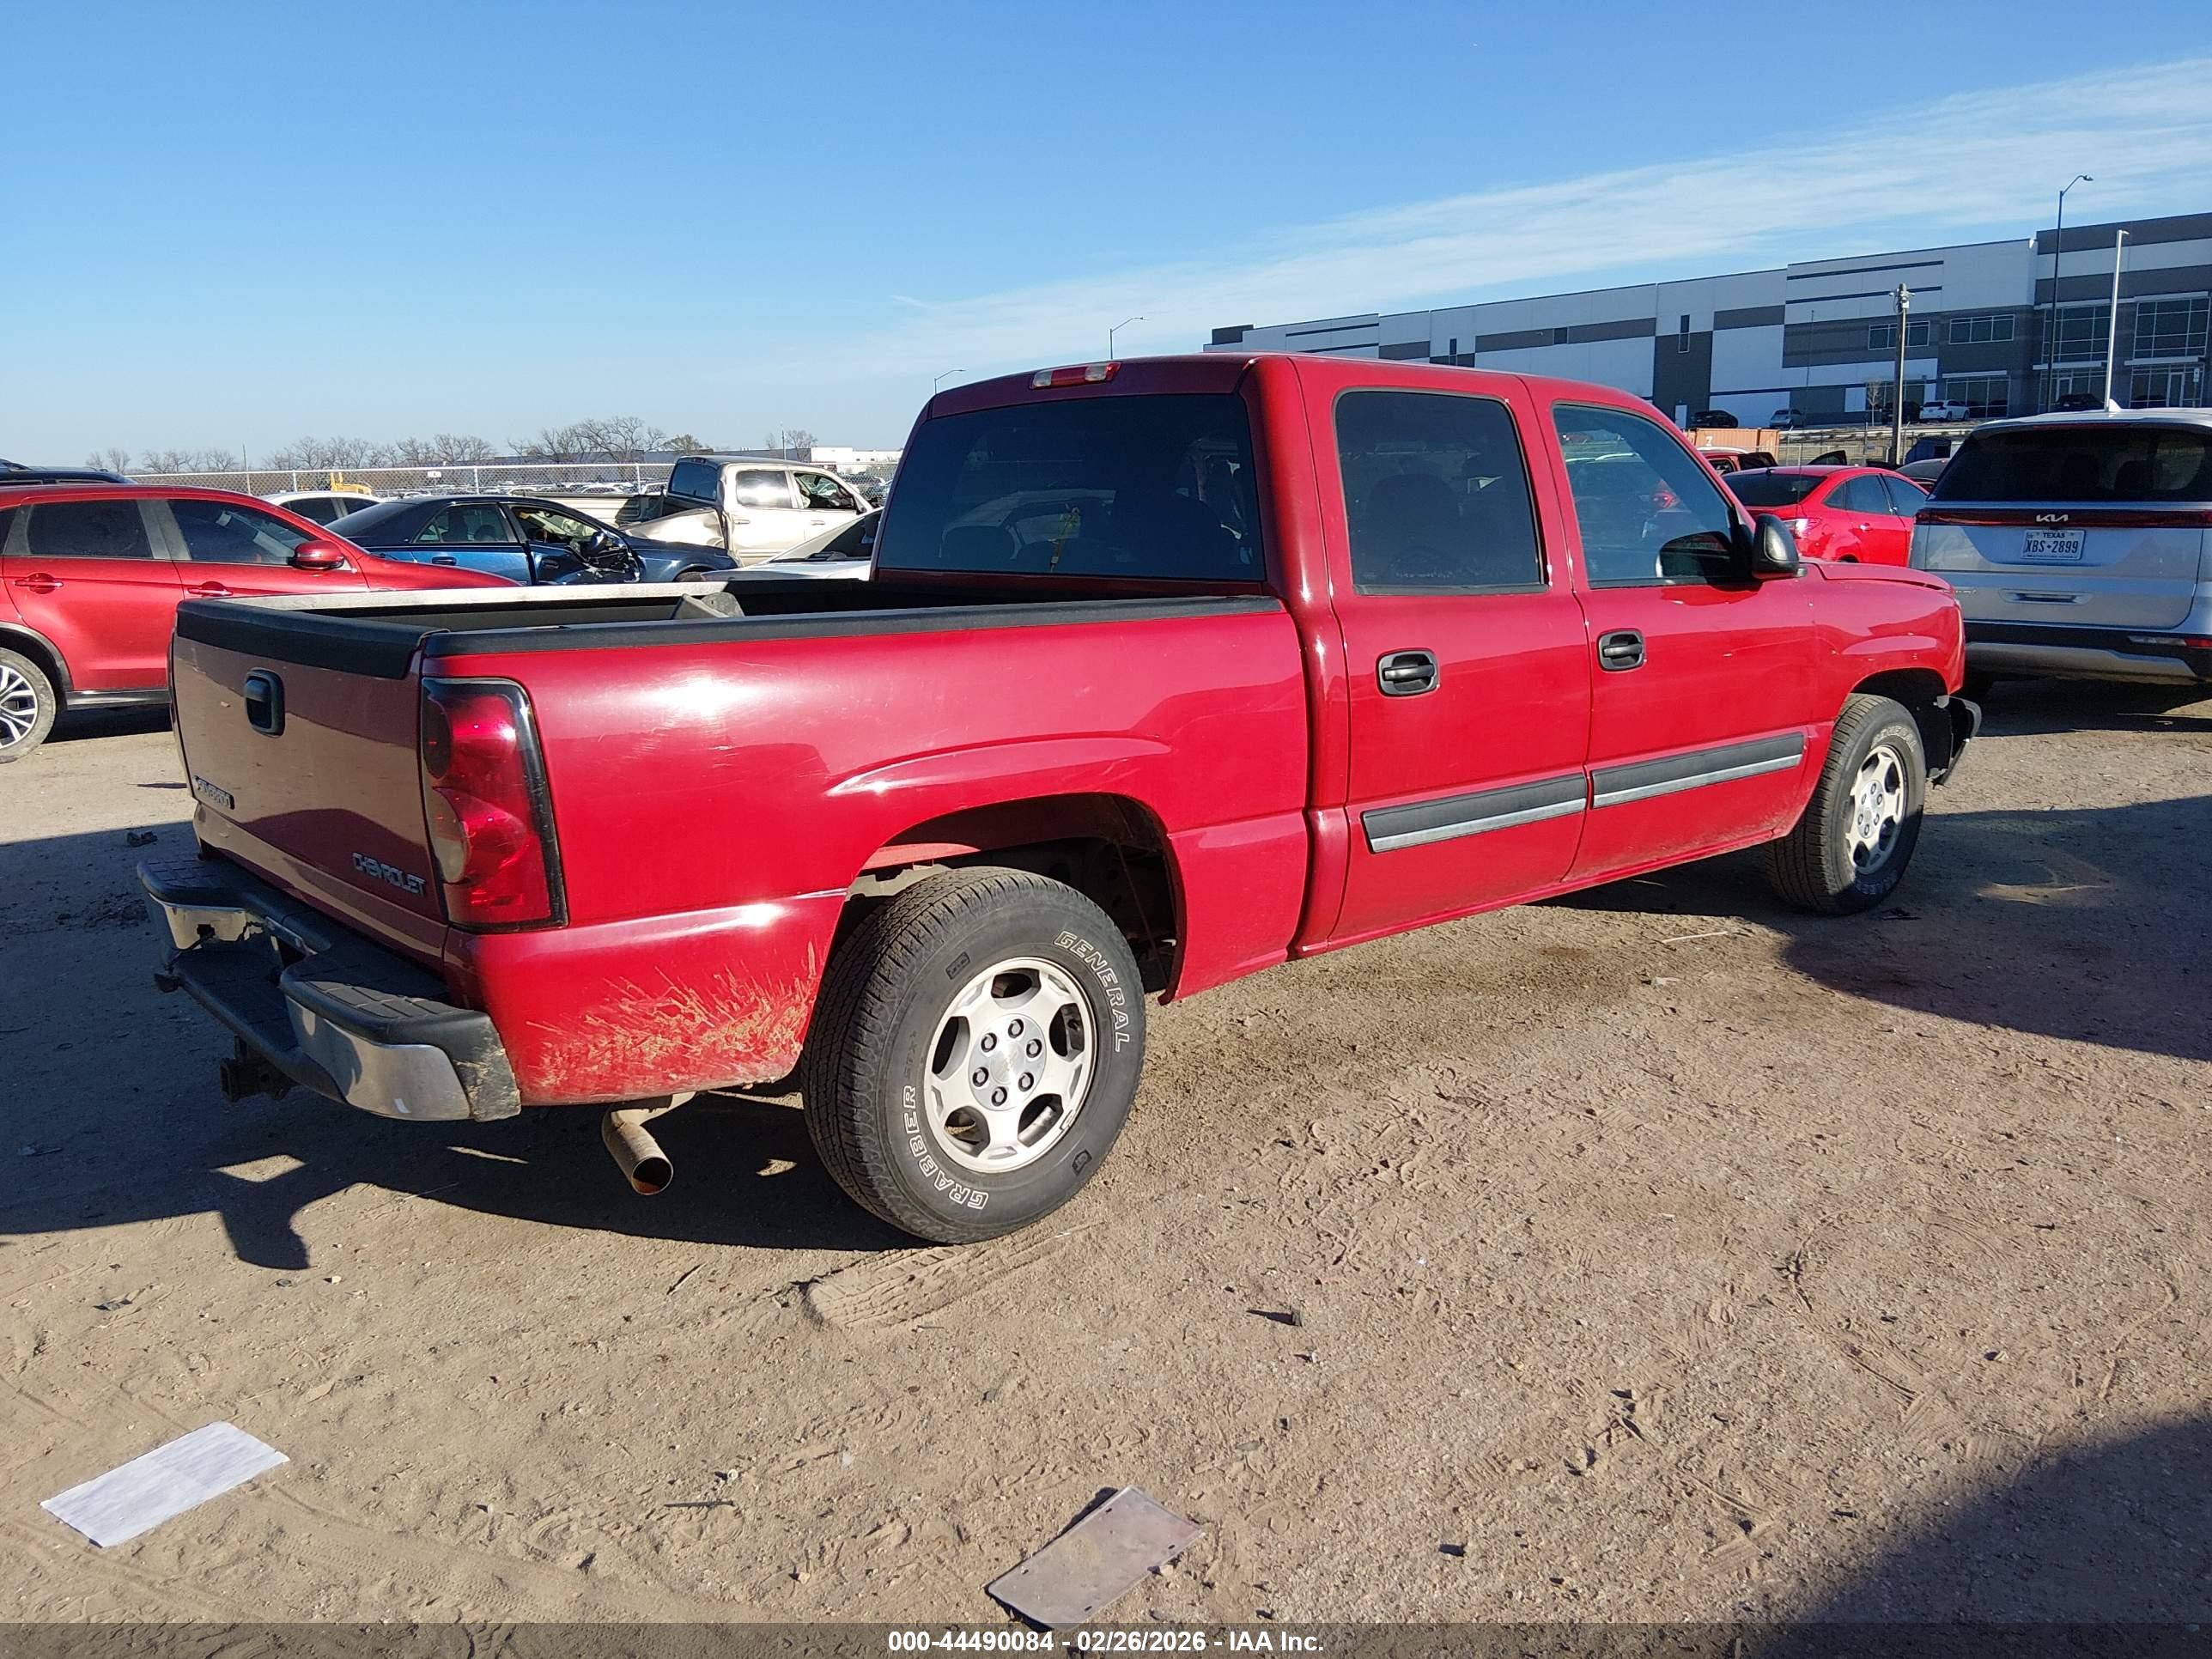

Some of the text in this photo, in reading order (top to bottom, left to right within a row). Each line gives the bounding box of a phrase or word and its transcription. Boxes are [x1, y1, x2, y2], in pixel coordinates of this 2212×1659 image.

[351, 852, 427, 897] CHEVROLET
[1054, 930, 1130, 1052] GENERAL
[903, 1085, 989, 1210] GRABBER
